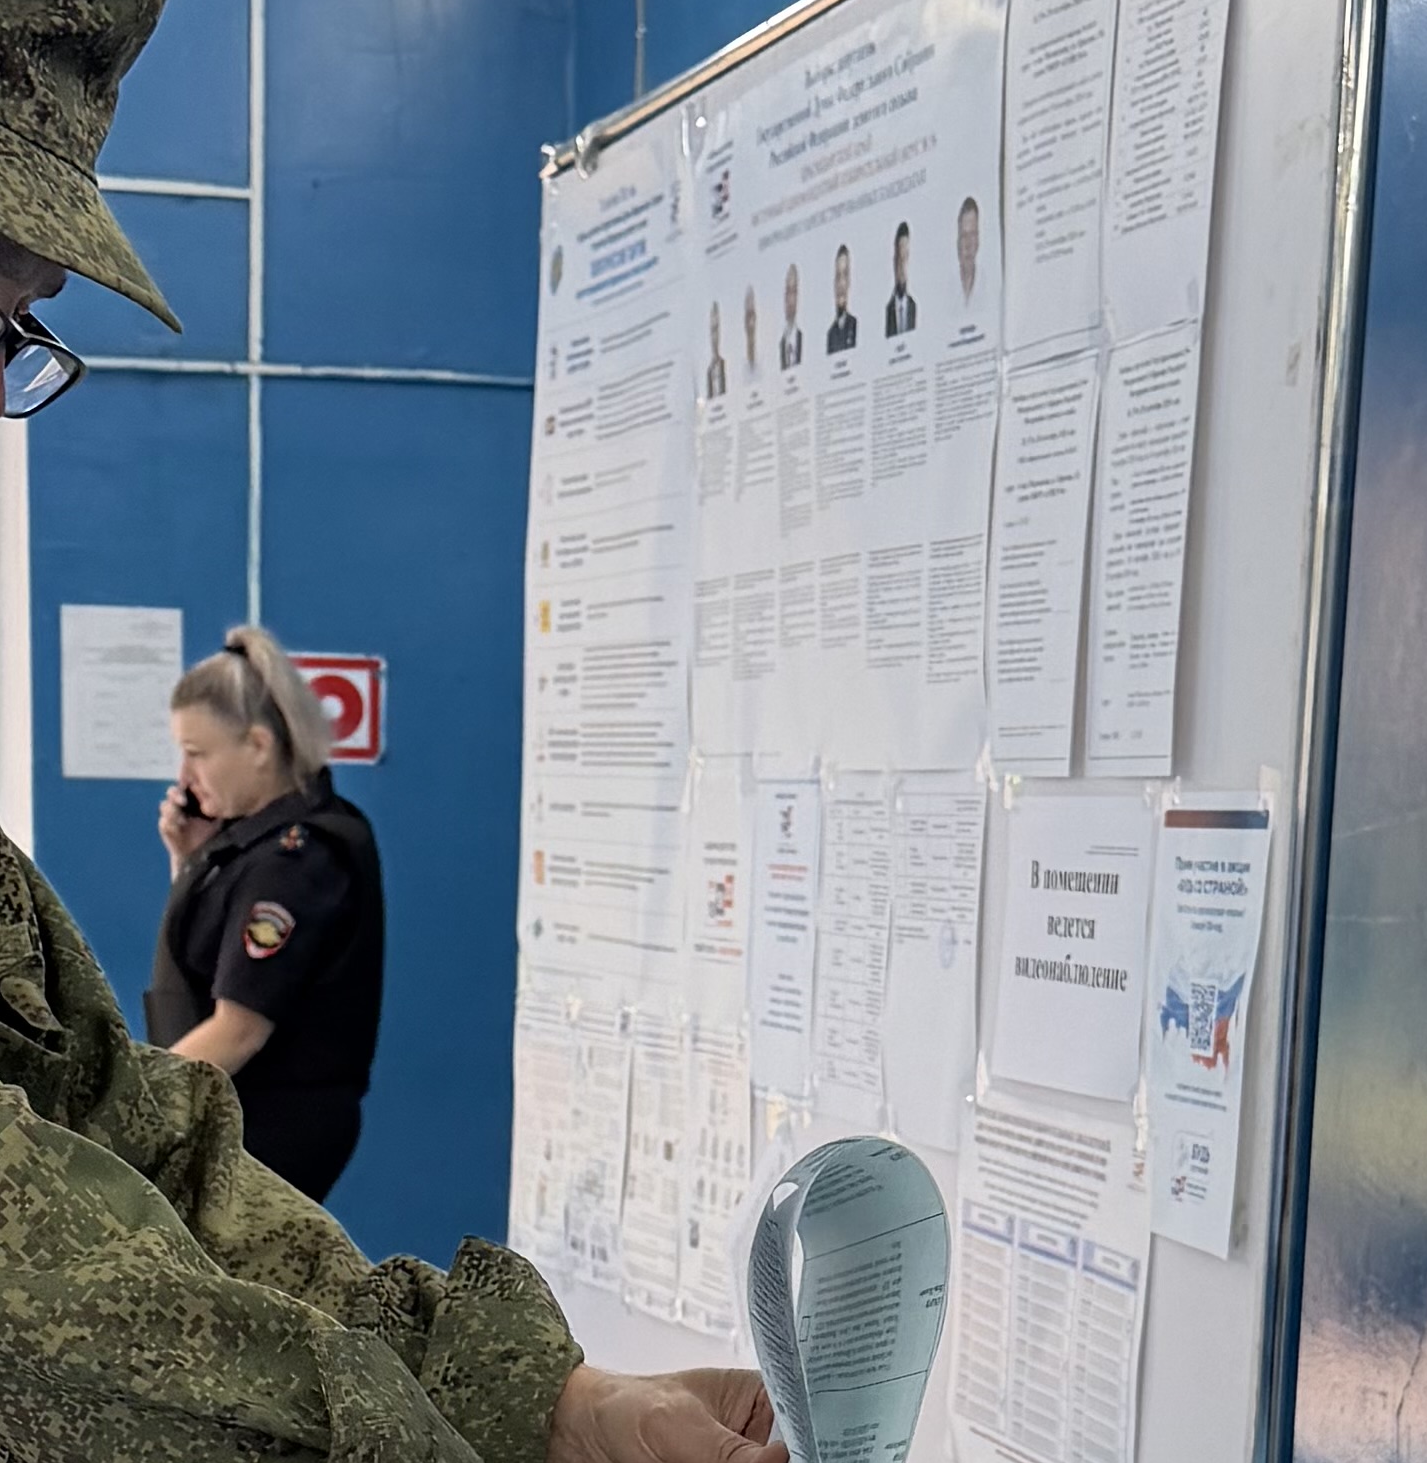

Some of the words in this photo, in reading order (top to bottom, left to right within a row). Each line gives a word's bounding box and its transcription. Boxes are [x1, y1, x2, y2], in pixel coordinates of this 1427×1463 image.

[1030, 860, 1040, 889] В
[1042, 867, 1120, 895] помещении
[1047, 914, 1095, 940] ведется
[1014, 953, 1128, 992] видеонаблюдение
